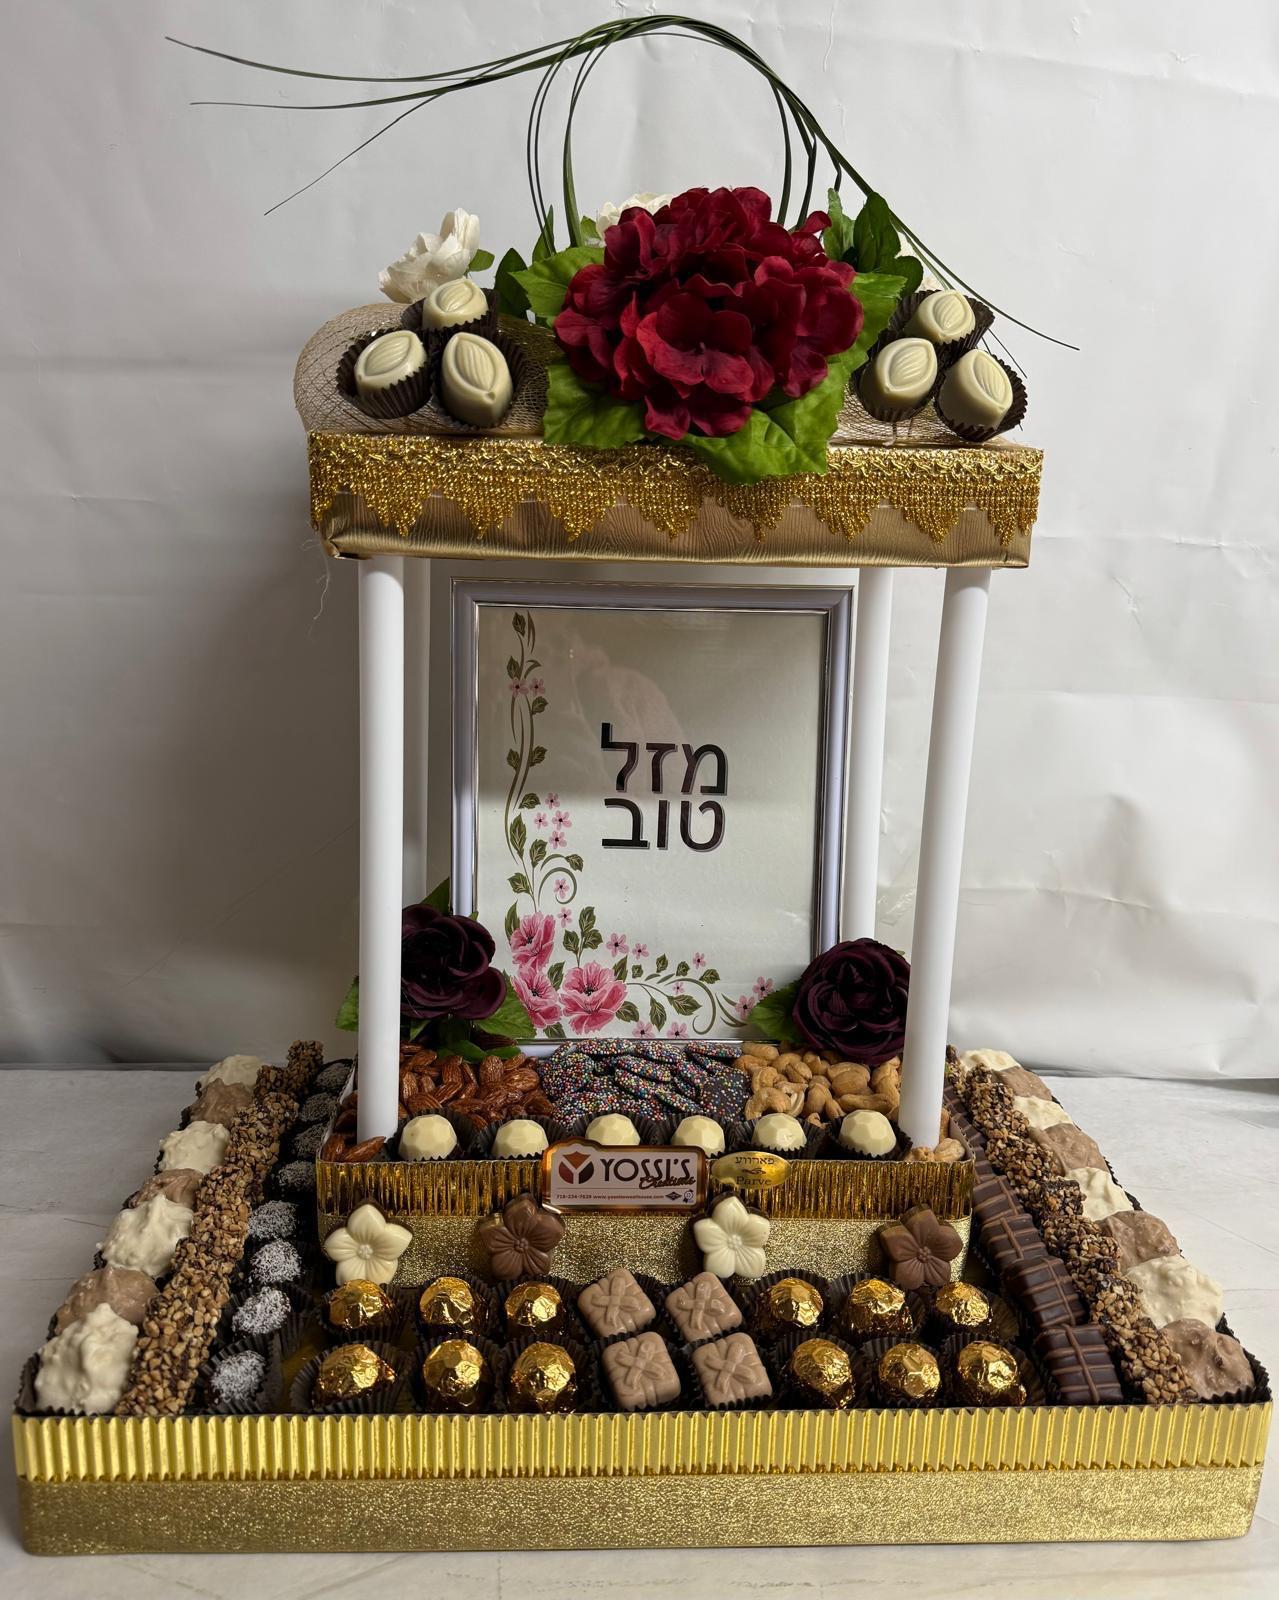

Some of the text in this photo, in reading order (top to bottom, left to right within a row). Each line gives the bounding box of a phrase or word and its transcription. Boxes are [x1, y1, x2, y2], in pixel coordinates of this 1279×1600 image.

[601, 722, 728, 795] מזל
[602, 798, 725, 852] טוב
[600, 1158, 690, 1182] YOSSI'S
